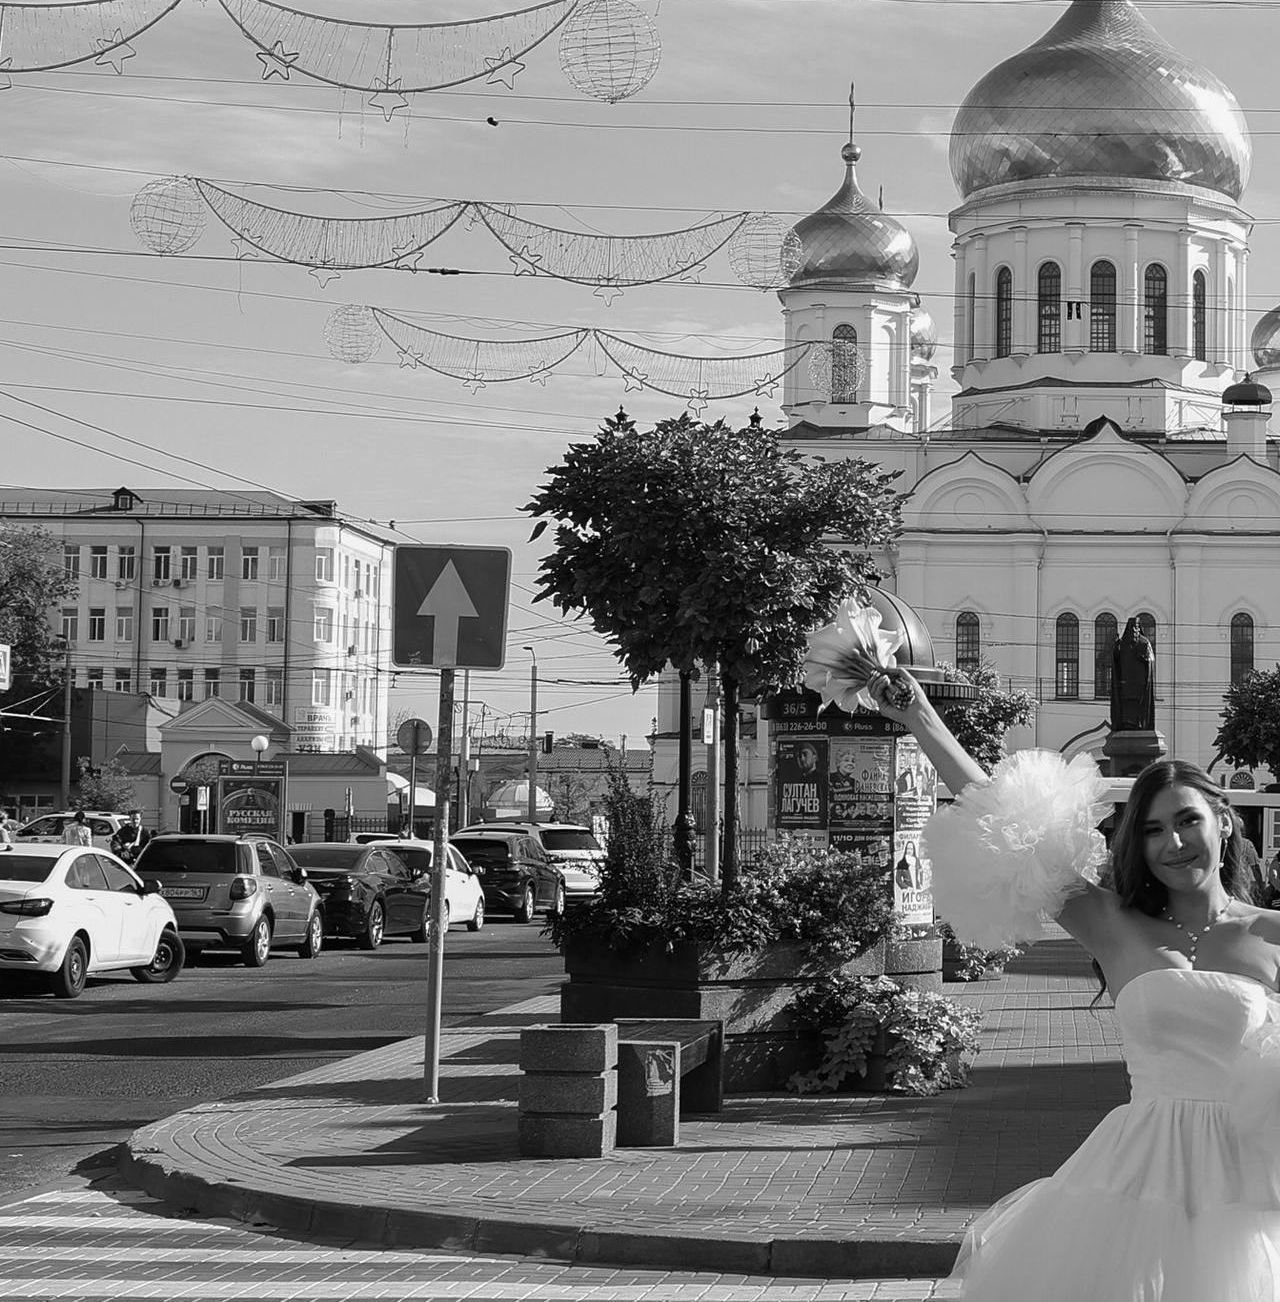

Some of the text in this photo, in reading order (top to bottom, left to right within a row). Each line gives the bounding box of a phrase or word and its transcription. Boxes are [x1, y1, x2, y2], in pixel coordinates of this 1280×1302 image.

[783, 702, 807, 715] 36/5
[790, 721, 827, 731] 226-26-00
[854, 723, 873, 731] Russ
[885, 722, 891, 731] 8
[783, 783, 817, 798] СУЛТАН
[781, 798, 820, 813] ЛАГУЧЕВ
